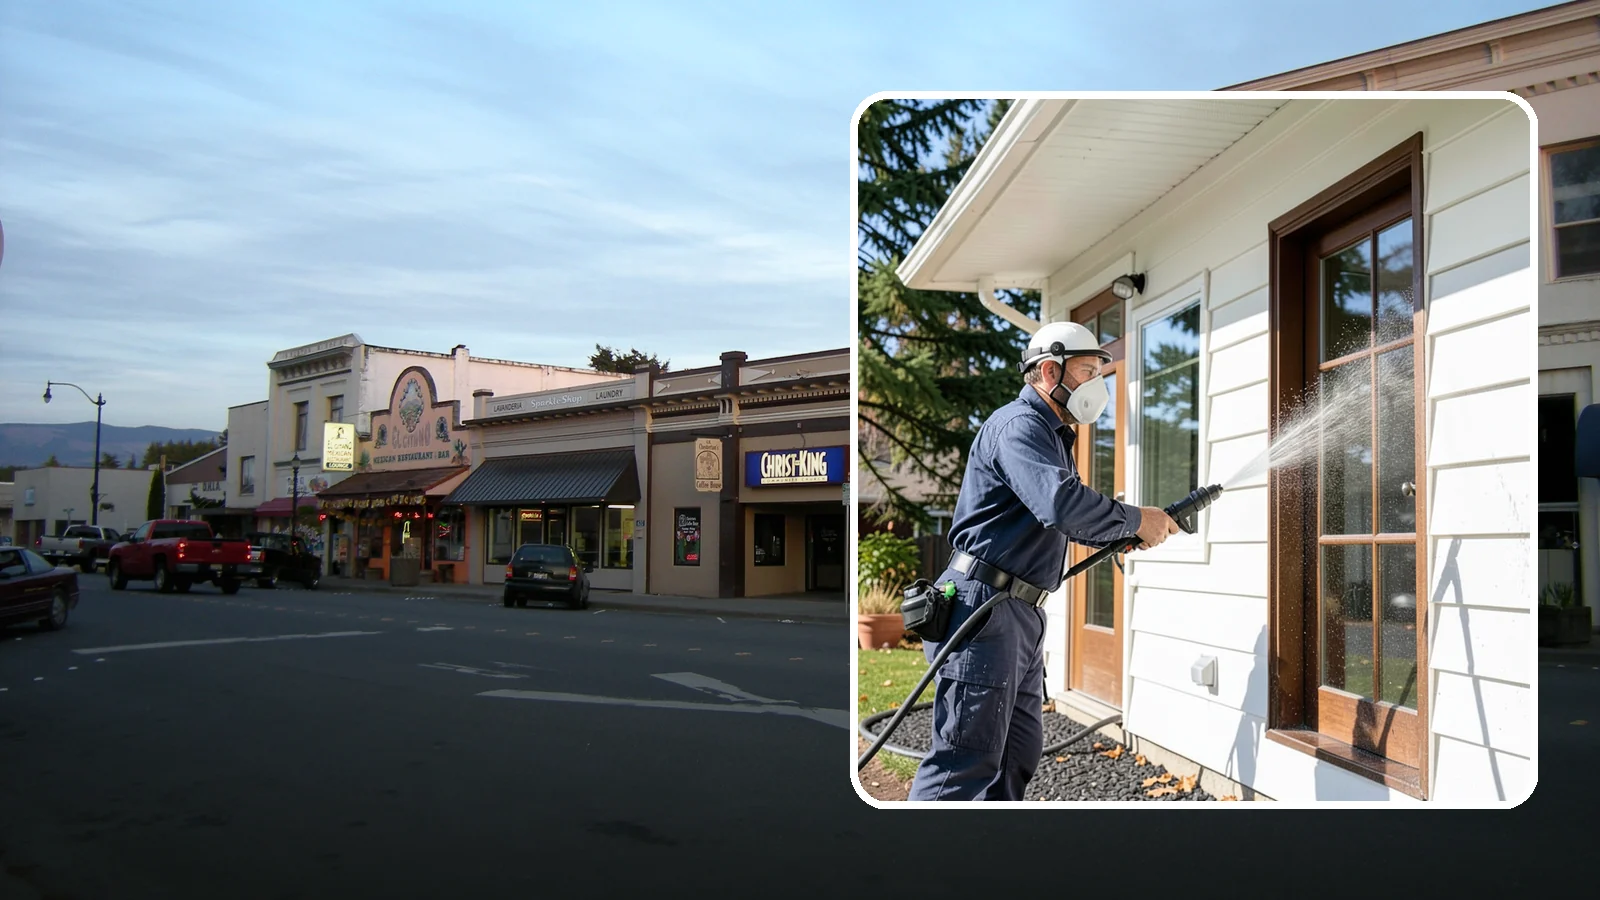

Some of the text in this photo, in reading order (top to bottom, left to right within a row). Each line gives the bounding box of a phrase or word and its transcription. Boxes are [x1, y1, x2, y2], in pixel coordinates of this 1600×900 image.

[493, 402, 523, 413] LAVANDERIA
[561, 394, 583, 406] Shop
[595, 388, 624, 400] LAUNDRY
[373, 450, 450, 464] MEXICAN RESTAURANT BAR
[760, 449, 828, 478] CHRIST KING
